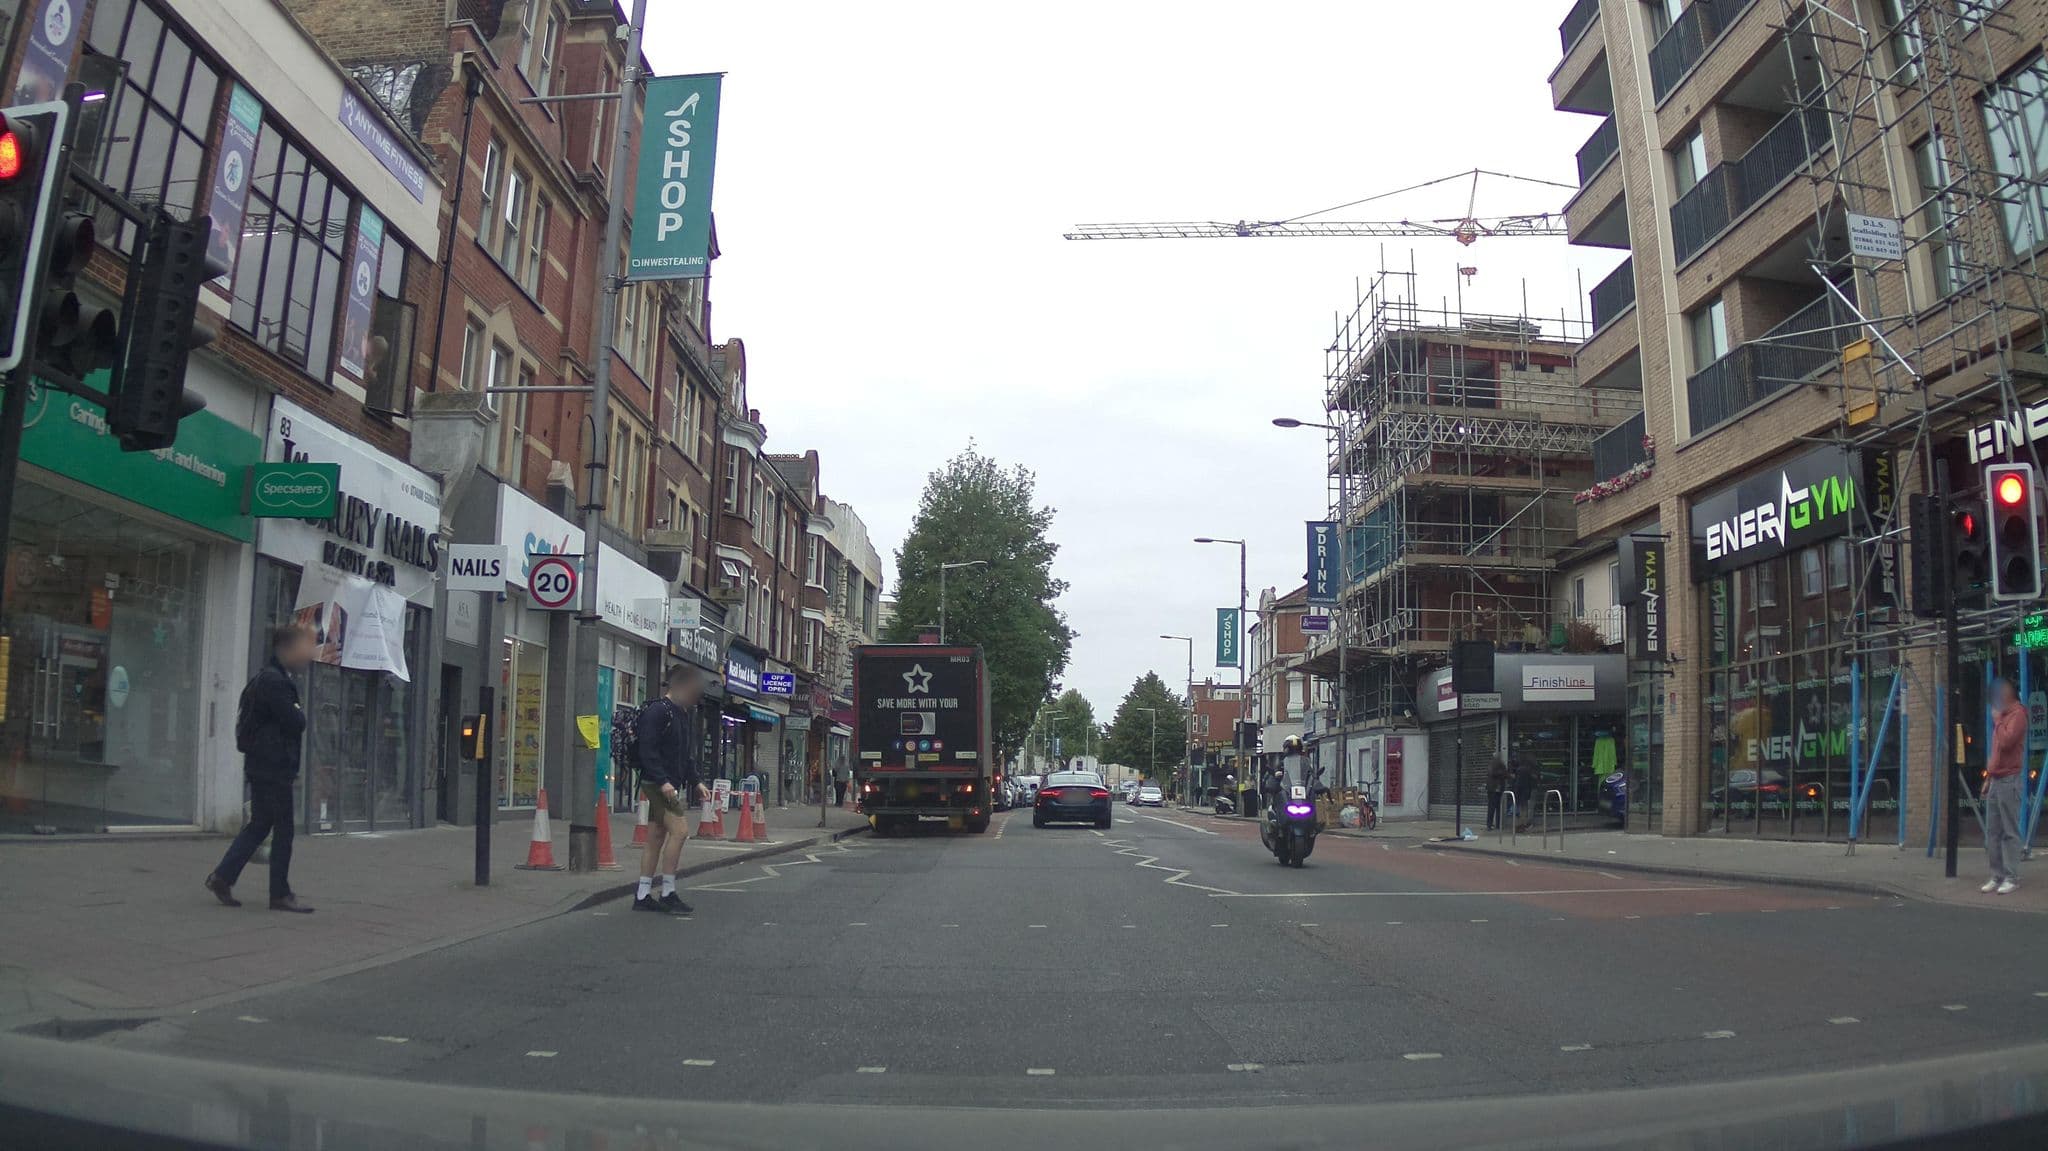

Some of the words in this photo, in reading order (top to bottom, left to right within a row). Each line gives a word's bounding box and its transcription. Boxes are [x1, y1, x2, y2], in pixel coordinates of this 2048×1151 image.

[354, 110, 391, 155] ANYTIME
[390, 147, 424, 190] FITNESS
[657, 119, 692, 242] SHOP
[1851, 226, 1887, 239] Scaffolding
[640, 256, 704, 267] INWESTEALING
[69, 401, 105, 436] Caring
[280, 417, 292, 438] 83
[174, 452, 193, 470] and
[193, 455, 227, 487] hearing
[263, 482, 324, 496] Specsavers
[1706, 470, 1855, 561] ENERGYM
[384, 512, 440, 572] NAILS
[451, 558, 500, 577] NAILS
[1317, 533, 1327, 594] DRINK
[537, 573, 569, 593] 20
[604, 600, 622, 617] HEALTH
[626, 609, 640, 627] HOME
[1223, 621, 1232, 657] SHOP
[877, 698, 895, 709] SAVE
[896, 698, 916, 709] MORE
[918, 698, 937, 709] WITH
[939, 698, 958, 709] YOUR
[1295, 788, 1303, 796] L
